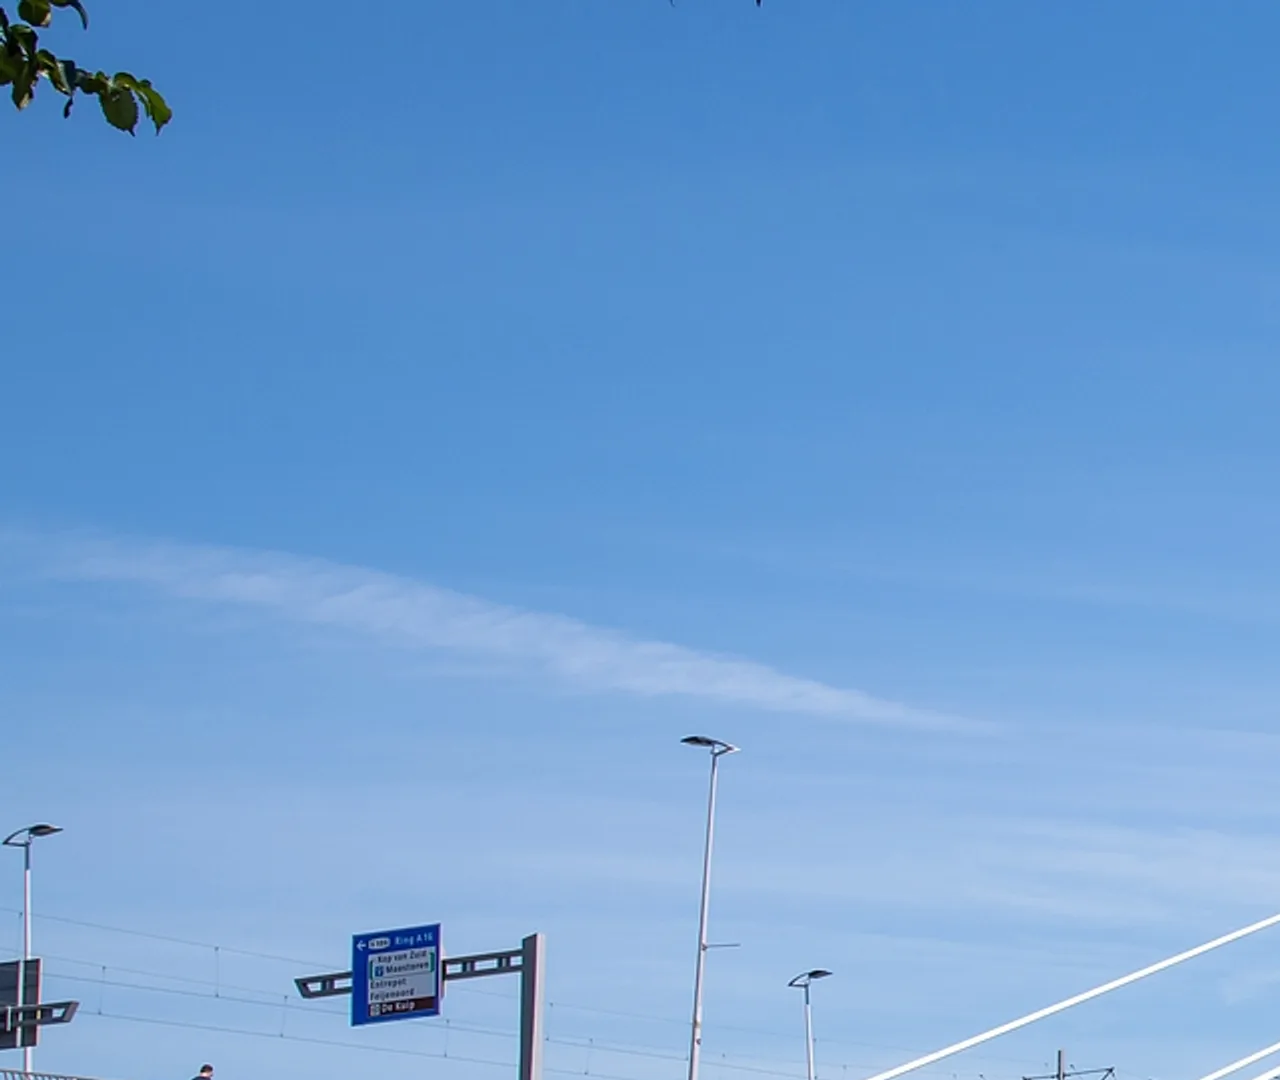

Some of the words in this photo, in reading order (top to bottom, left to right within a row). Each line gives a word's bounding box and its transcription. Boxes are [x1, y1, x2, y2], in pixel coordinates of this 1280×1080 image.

[395, 937, 413, 946] Ring
[378, 955, 392, 963] Kop
[394, 952, 408, 961] van
[410, 950, 428, 959] Zuid
[382, 1004, 393, 1012] De
[396, 1001, 416, 1011] Kuip
